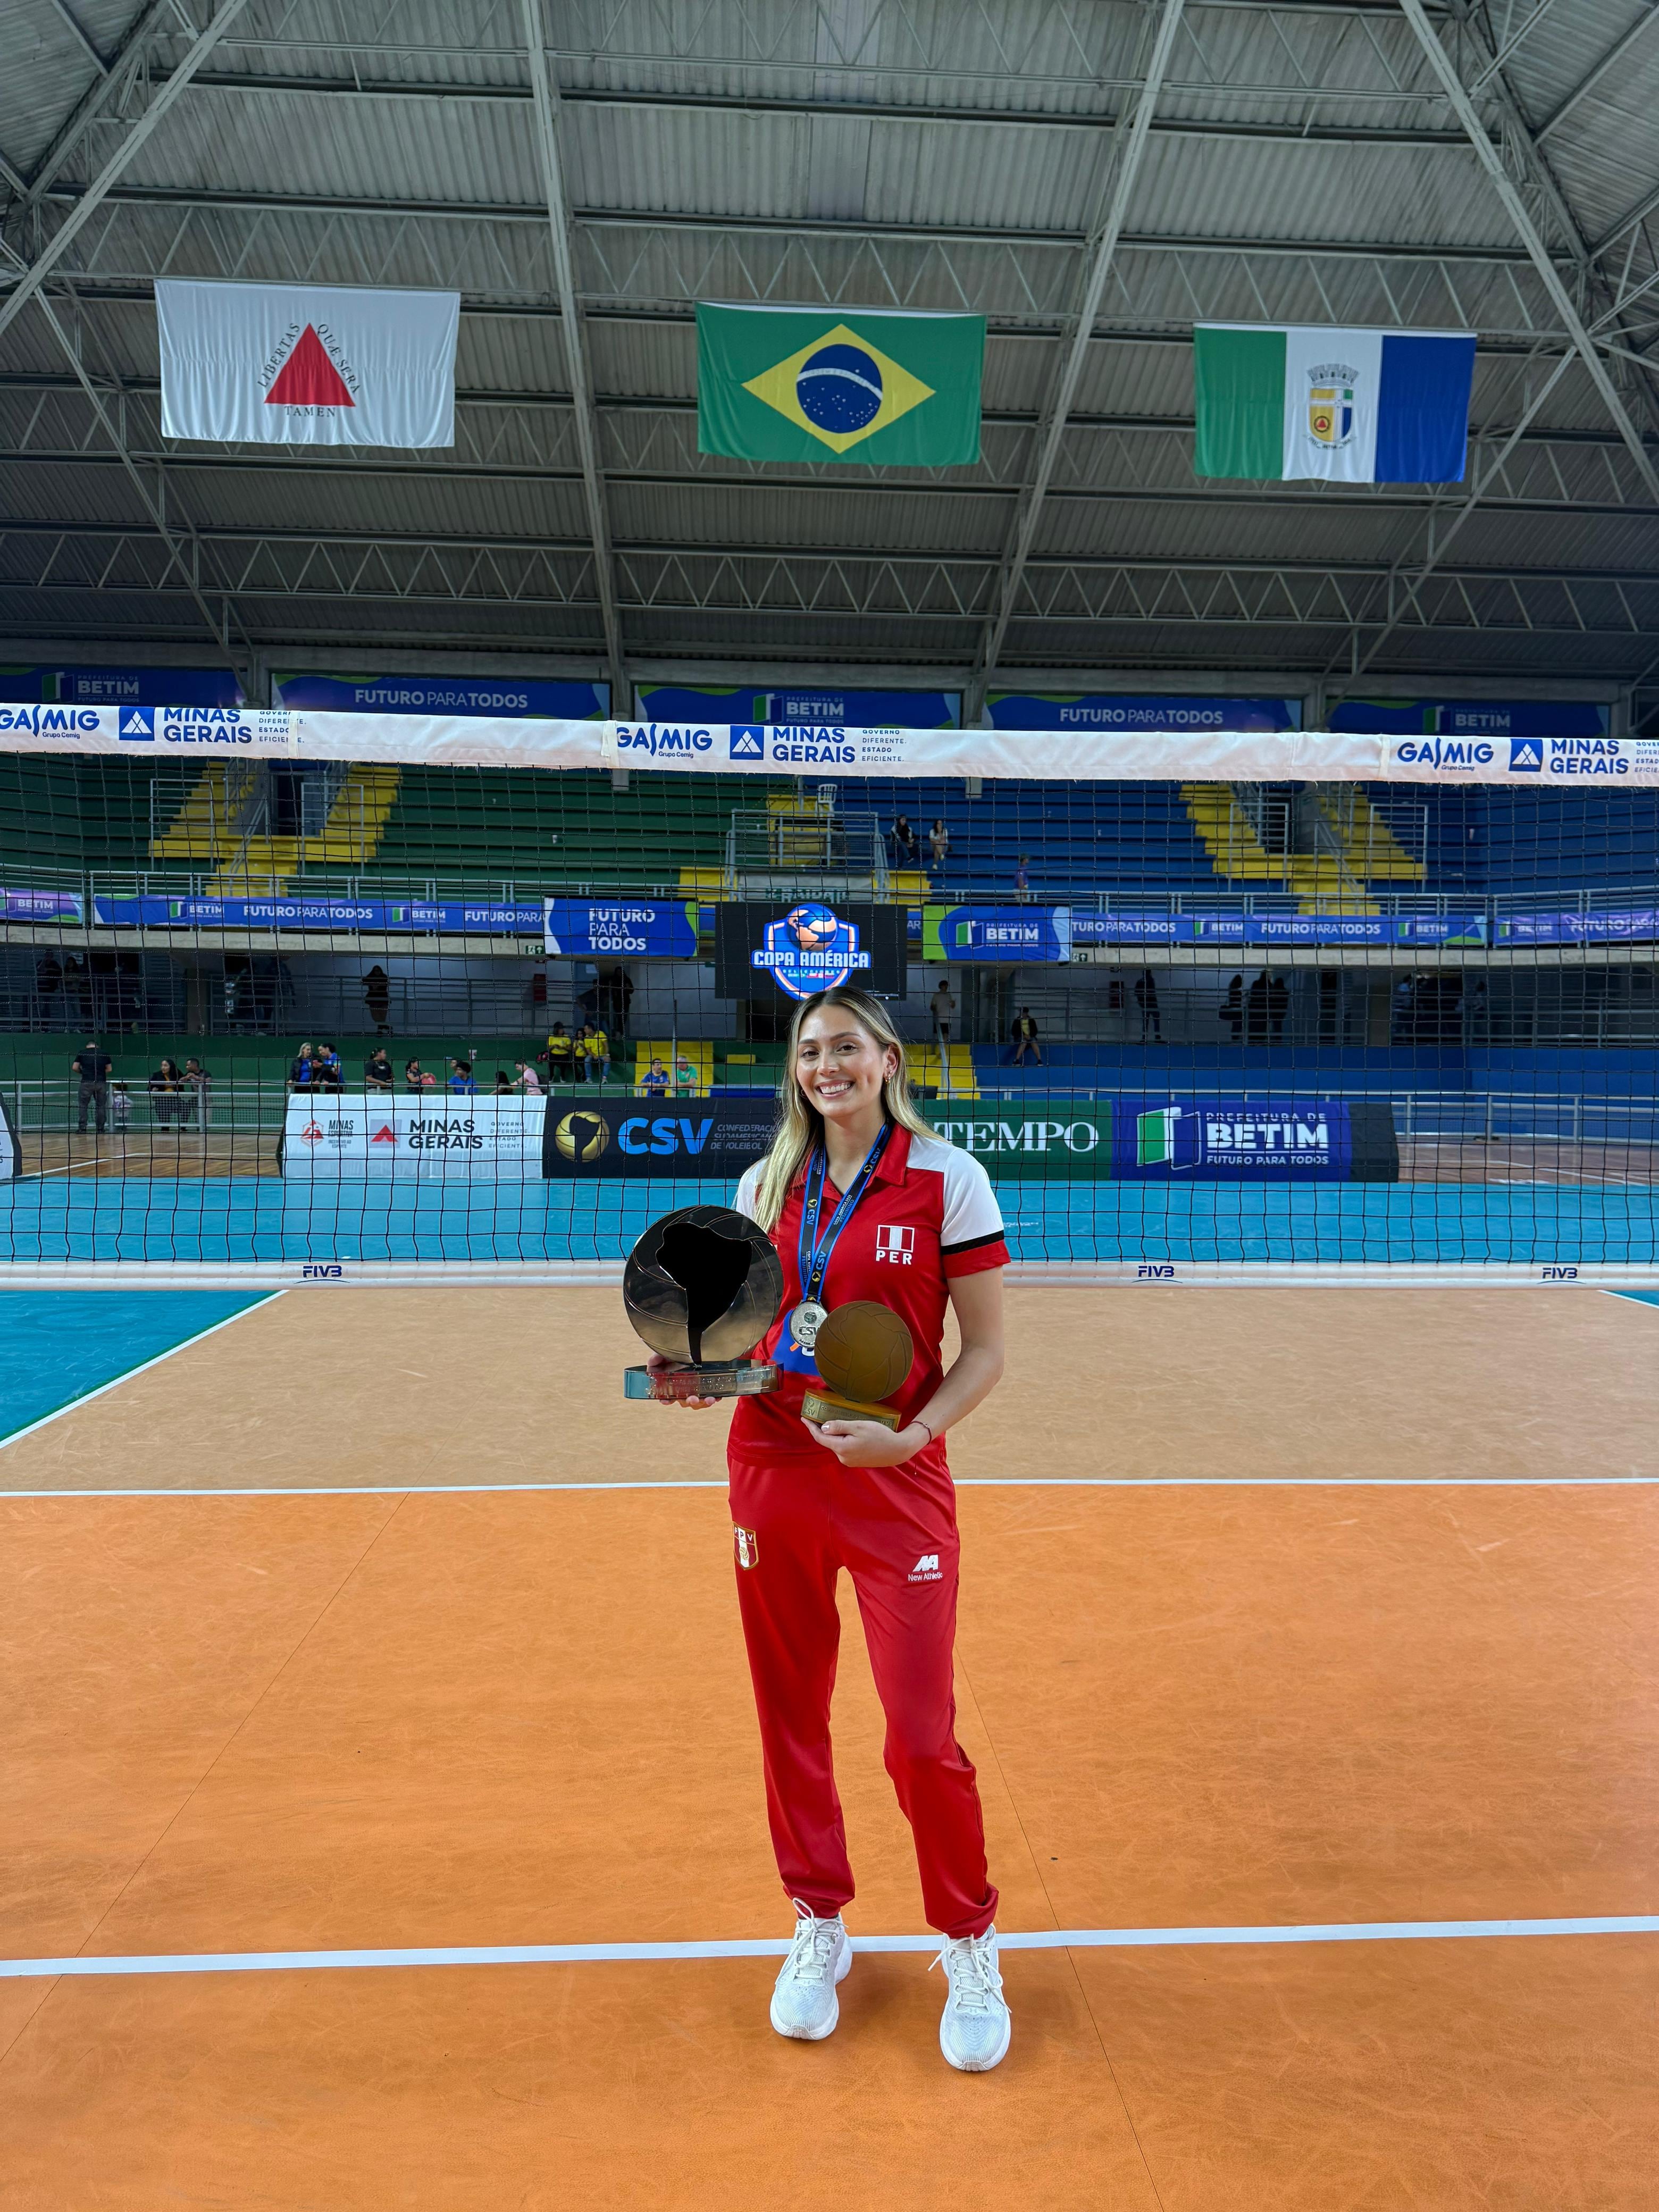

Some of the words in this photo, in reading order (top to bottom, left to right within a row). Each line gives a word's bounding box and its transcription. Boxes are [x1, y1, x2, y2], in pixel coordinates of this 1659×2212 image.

[257, 323, 300, 388] LIBERTAS
[336, 358, 360, 394] SERA
[284, 405, 336, 417] TAMEN
[78, 681, 139, 694] BETIM
[355, 690, 424, 705] FUTURO
[428, 692, 467, 706] PARA
[467, 693, 527, 708] TODOS
[164, 707, 241, 723] MINAS
[786, 702, 844, 716] BETIM
[0, 705, 99, 738] GASMIG
[1060, 708, 1125, 722] FUTURO
[1128, 710, 1166, 723] PARA
[1167, 710, 1222, 725] TODOS
[1455, 714, 1510, 727] BETIM
[163, 724, 252, 743] GERAIS
[617, 723, 713, 757] GASMIG
[773, 727, 845, 743] MINAS
[773, 744, 855, 763] GERAIS
[1397, 738, 1494, 769] GASMIG
[1551, 740, 1619, 755] MINAS
[1550, 757, 1629, 774] GERAIS
[18, 899, 53, 909] BETIM
[189, 906, 224, 914] BETIM
[244, 906, 295, 917] FUTURO
[297, 907, 327, 918] PARA
[328, 908, 373, 919] TODOS
[412, 910, 446, 919] BETIM
[465, 911, 515, 921] FUTURO
[589, 908, 655, 923] FUTURO
[590, 923, 630, 936] PARA
[986, 928, 1038, 940] BETIM
[1106, 923, 1133, 932] PARA
[1134, 923, 1176, 932] TODOS
[1261, 923, 1309, 934] FUTURO
[1311, 924, 1338, 934] PARA
[1339, 924, 1380, 934] TODOS
[589, 937, 646, 951] TODOS
[754, 952, 795, 966] COPA
[800, 950, 869, 968] AMÉRICA
[1206, 1112, 1301, 1122] PREFEITURA
[1308, 1113, 1326, 1122] DE
[329, 1120, 354, 1130] MINAS
[409, 1119, 475, 1133] MINAS
[408, 1136, 482, 1149] GERAIS
[618, 1117, 714, 1155] CSV
[934, 1121, 1099, 1152] TEMPO
[1206, 1123, 1328, 1149] BETIM
[1206, 1155, 1253, 1164] FUTURO
[1256, 1155, 1286, 1164] PARA
[1290, 1155, 1329, 1165] TODOS
[807, 1209, 815, 1225] CSV
[816, 1251, 826, 1270] CSV
[876, 1250, 912, 1265] PER
[303, 1266, 342, 1278] FIVB
[1138, 1266, 1174, 1277] FIVB
[1542, 1268, 1578, 1279] FIVB
[735, 1527, 753, 1541] FPV
[924, 1572, 943, 1580] Athletic
